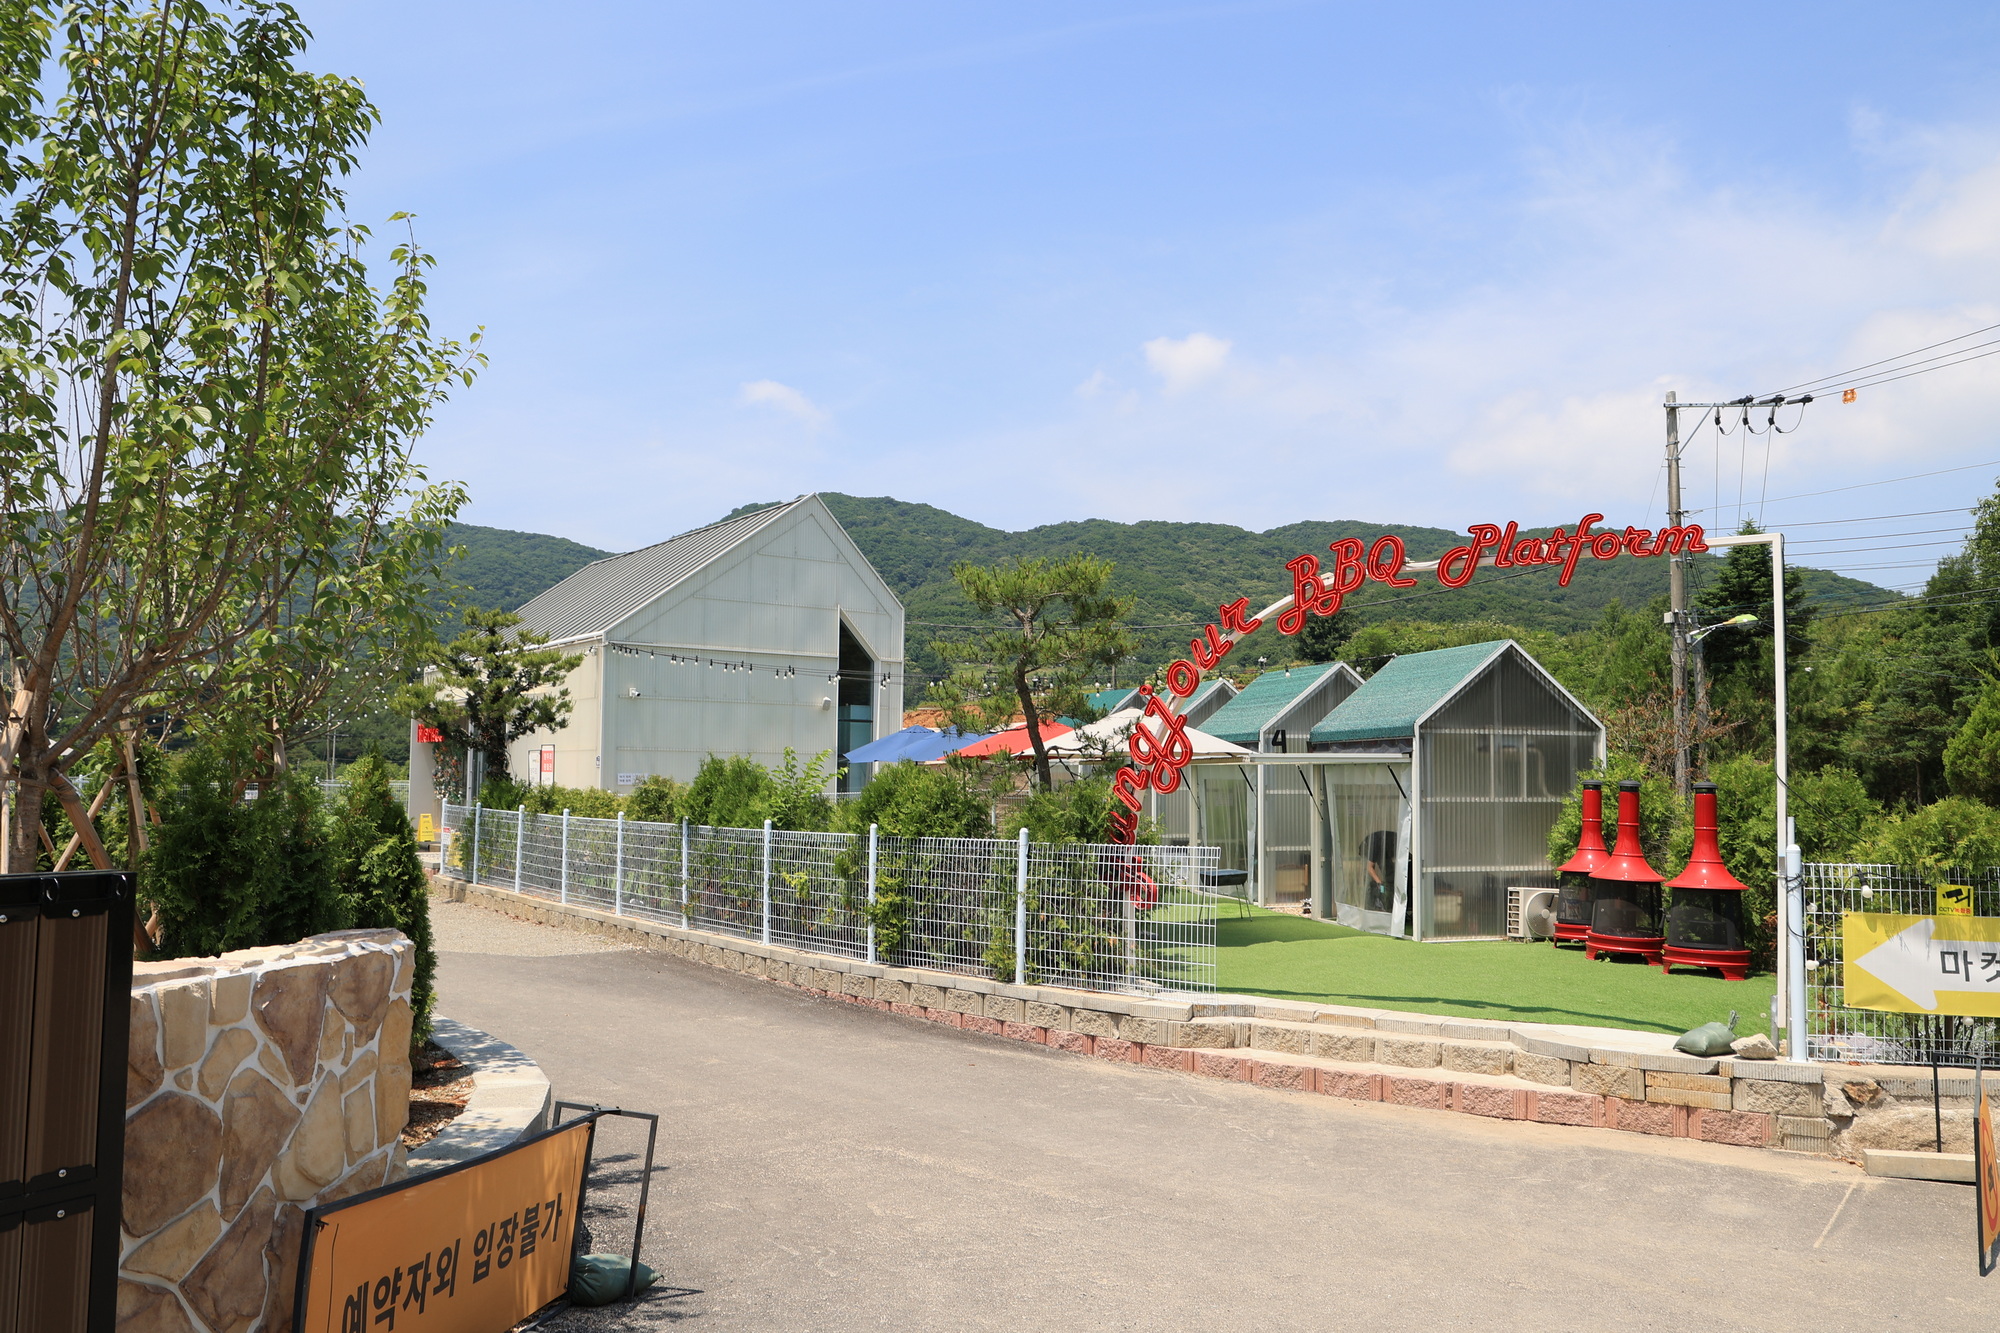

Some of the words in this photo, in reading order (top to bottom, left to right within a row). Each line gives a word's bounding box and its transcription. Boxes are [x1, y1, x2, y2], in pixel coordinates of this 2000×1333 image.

[1277, 534, 1417, 635] BBQ
[1437, 513, 1709, 587] Platform
[1271, 729, 1287, 753] 4
[341, 1238, 461, 1333] 예약자외
[472, 1192, 563, 1284] 입장불가
